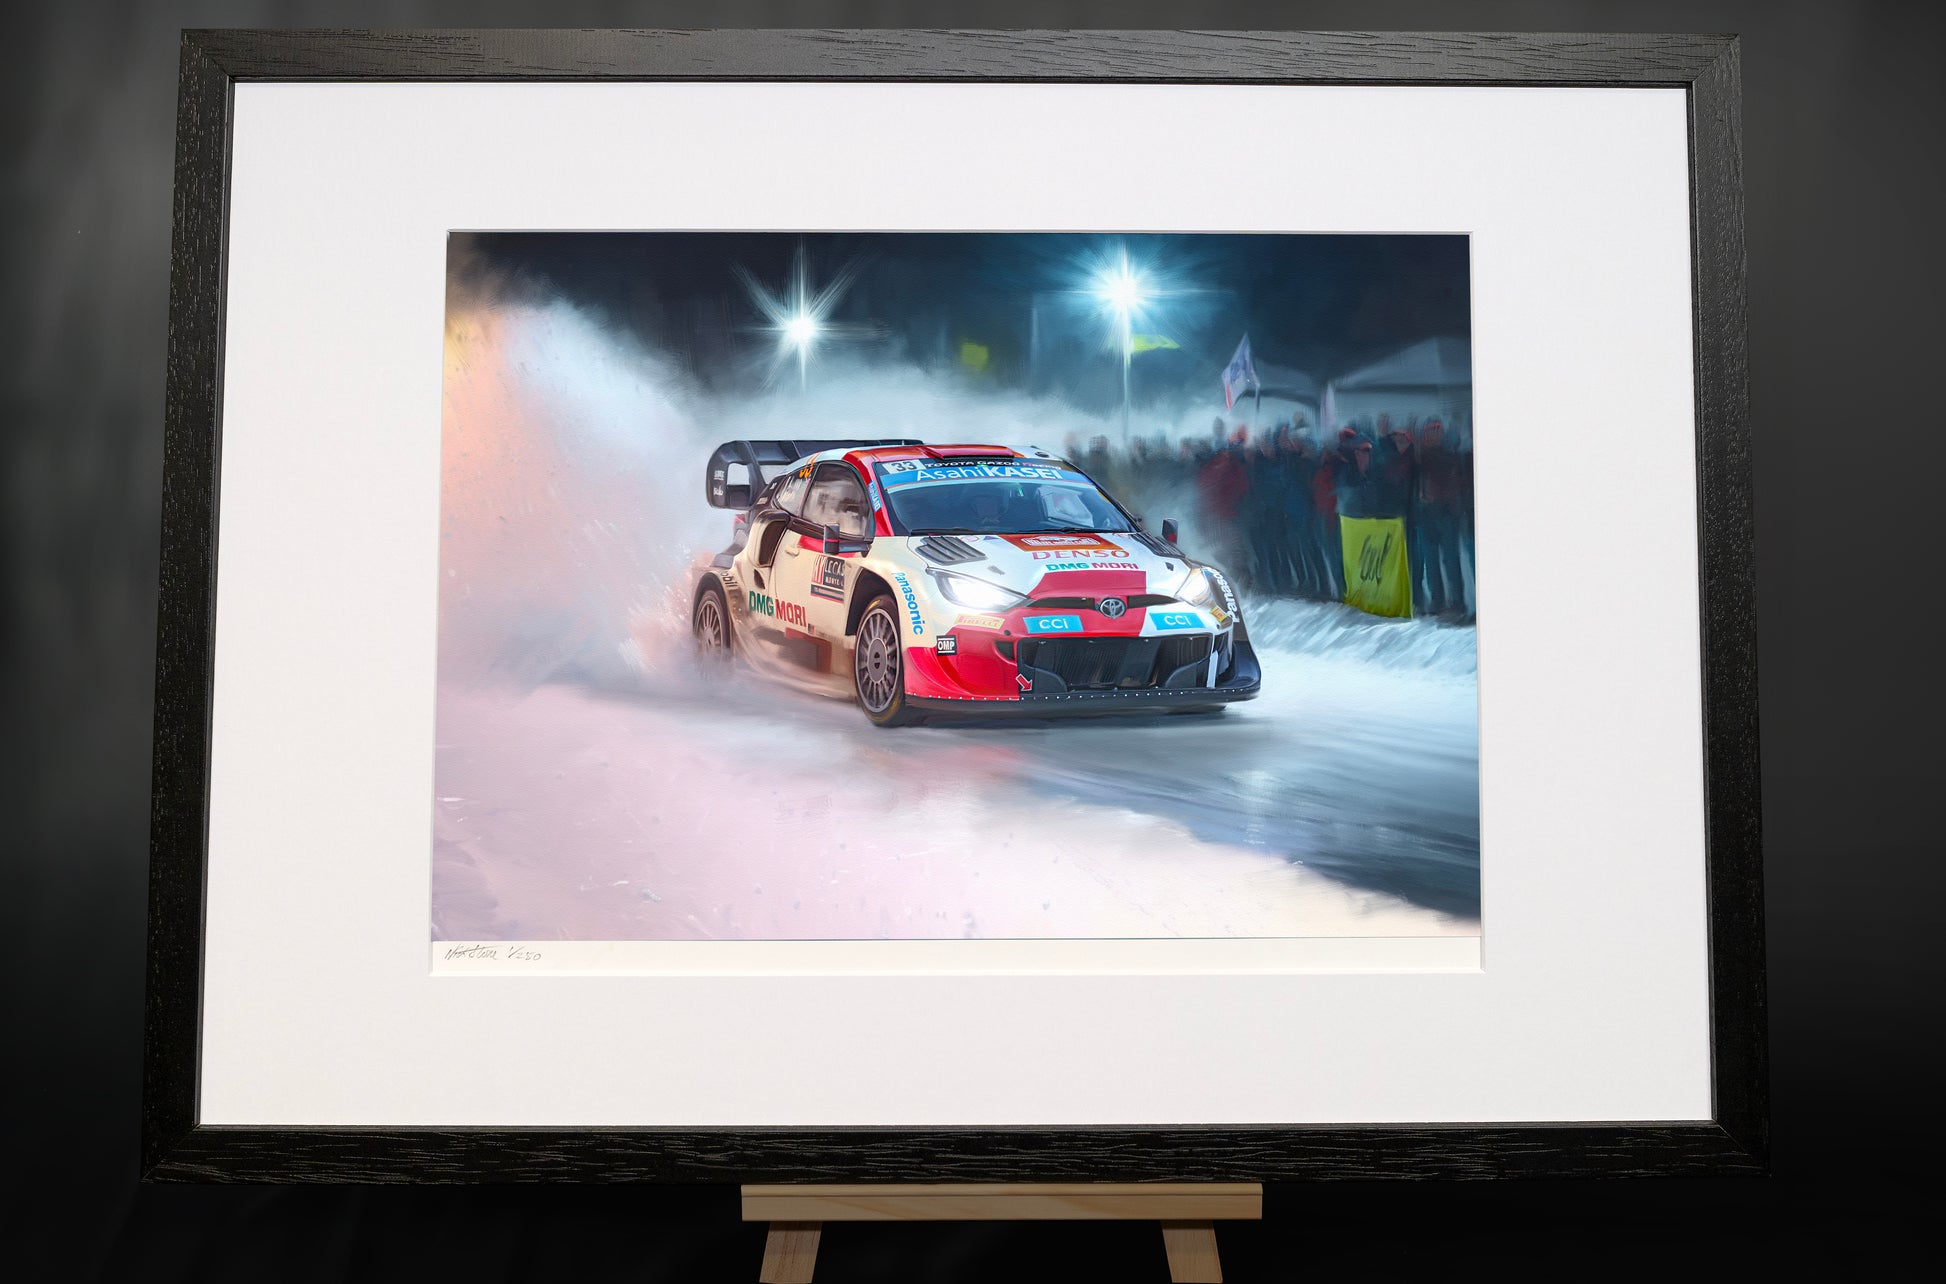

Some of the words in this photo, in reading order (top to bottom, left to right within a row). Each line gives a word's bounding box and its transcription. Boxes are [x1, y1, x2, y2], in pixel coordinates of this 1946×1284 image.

[891, 460, 917, 472] 33
[1032, 550, 1130, 560] DENSO
[1046, 563, 1089, 571] DMG
[1091, 562, 1139, 570] MORI
[749, 590, 775, 617] DMG
[775, 598, 807, 628] MORI
[892, 571, 924, 636] Panasonic
[937, 640, 956, 652] OMP
